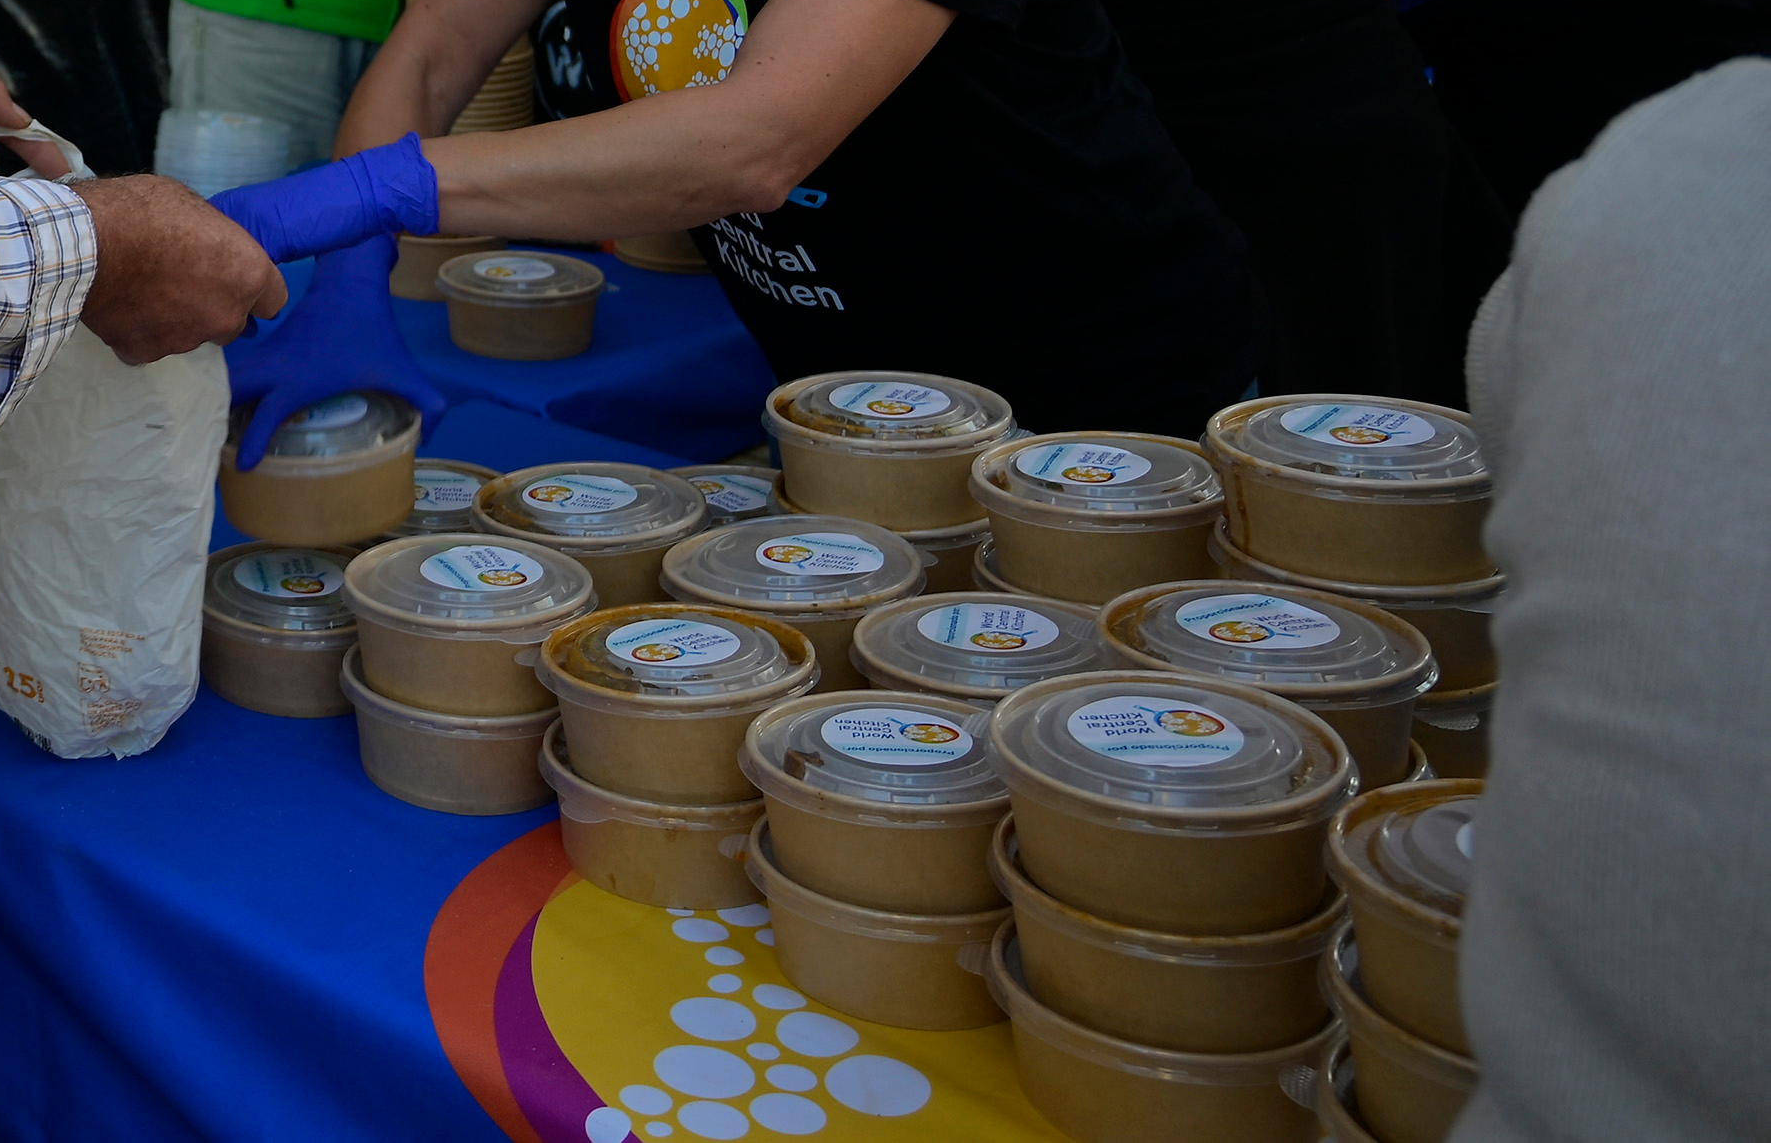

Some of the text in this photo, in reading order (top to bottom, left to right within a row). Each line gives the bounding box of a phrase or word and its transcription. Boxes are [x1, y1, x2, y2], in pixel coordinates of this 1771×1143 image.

[714, 233, 845, 310] Kitchen
[791, 537, 857, 551] Proporcionado
[821, 553, 855, 561] World
[809, 562, 855, 571] Kitchen
[816, 558, 859, 567] Central
[1184, 603, 1254, 622] Proporcionado
[1253, 613, 1293, 622] World
[980, 611, 994, 629] World
[996, 609, 1010, 629] Central
[1011, 610, 1025, 630] Kitchen
[1268, 617, 1317, 627] Central
[1280, 622, 1332, 632] Kitchen
[1078, 712, 1144, 721] Kitchen
[835, 718, 891, 728] Kitchen
[1087, 719, 1147, 729] Central
[838, 725, 892, 733] Central
[1105, 726, 1155, 737] World
[852, 731, 895, 739] World
[868, 746, 955, 756] Proporcionado
[1131, 743, 1230, 751] Proporcionado
